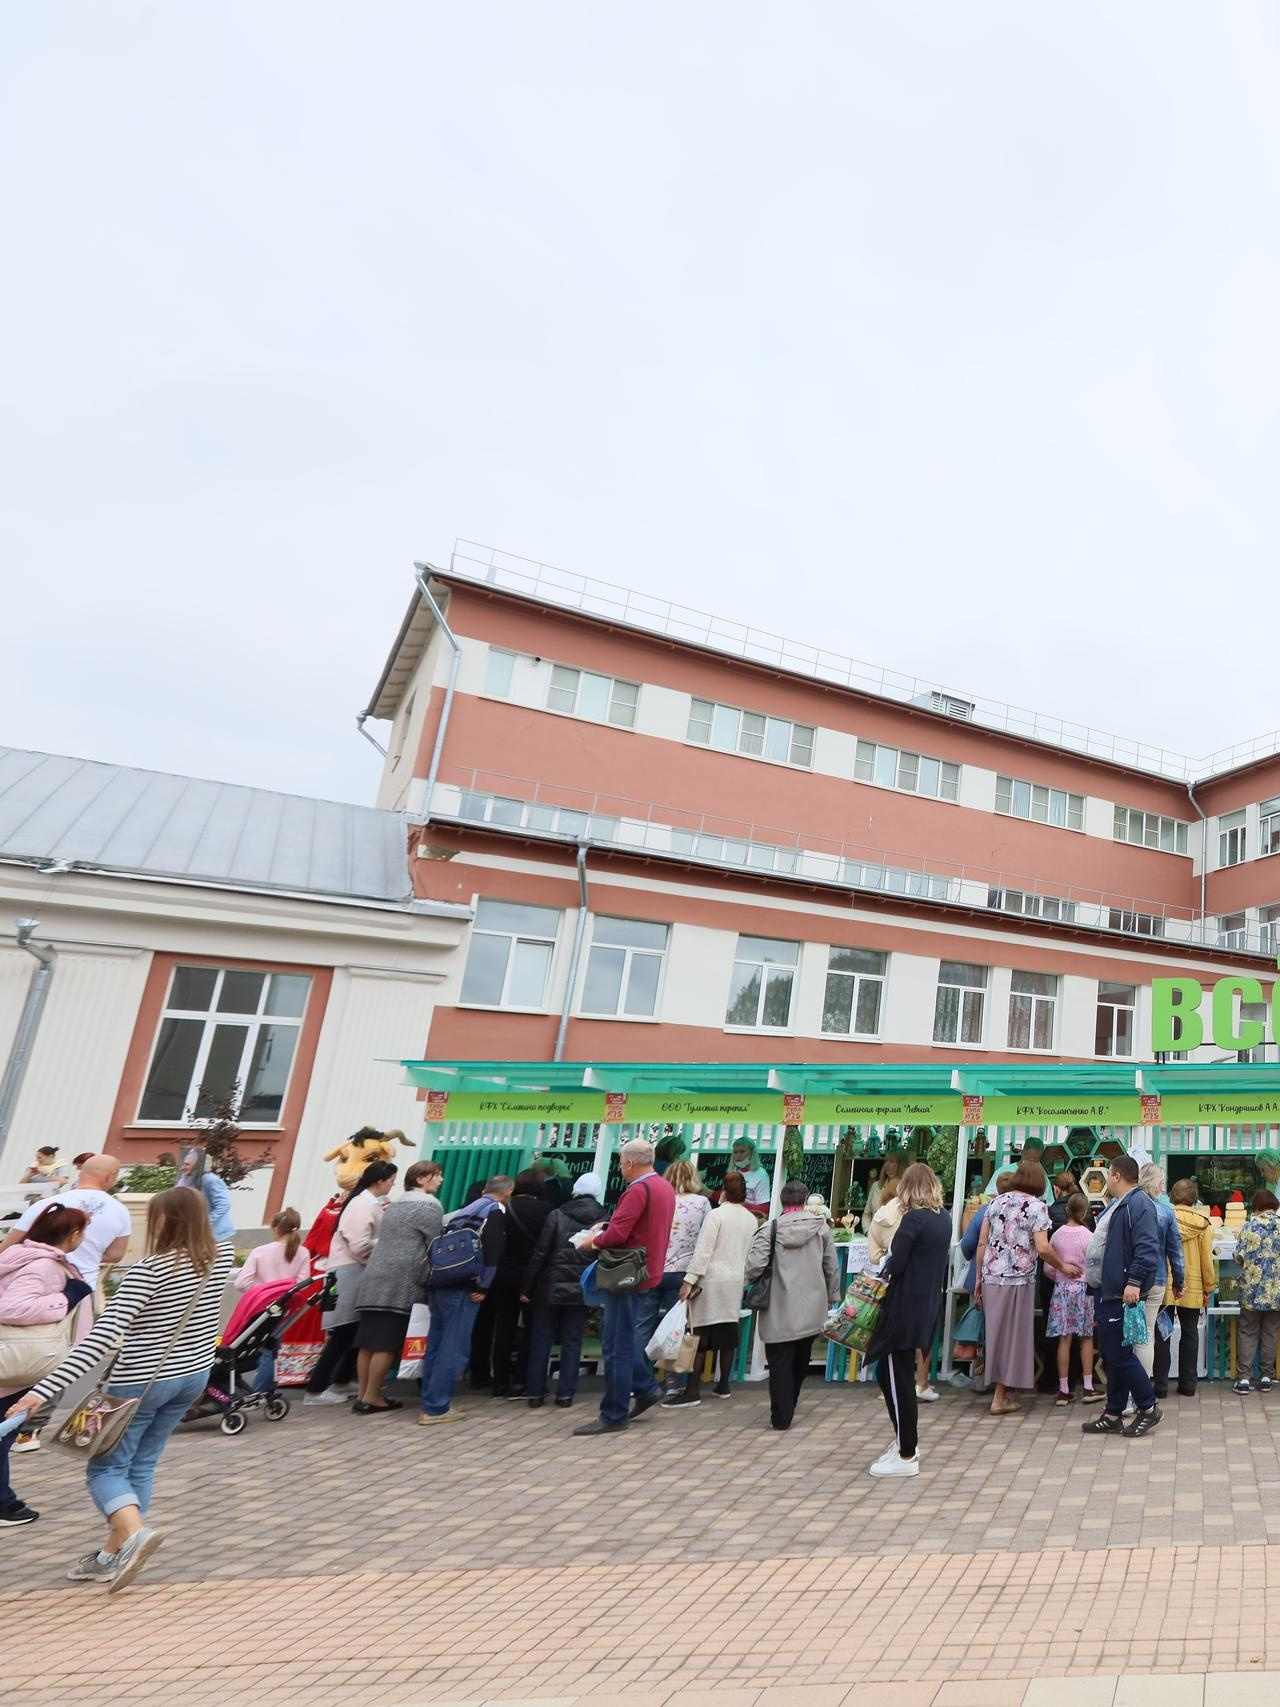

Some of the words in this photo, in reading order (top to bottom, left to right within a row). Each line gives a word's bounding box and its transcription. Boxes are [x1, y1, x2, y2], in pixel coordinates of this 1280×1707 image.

[480, 1101, 498, 1111] КФХ
[661, 1102, 682, 1112] ООО
[875, 1105, 902, 1116] ферма
[1016, 1105, 1034, 1115] КФХ
[1198, 1103, 1216, 1112] КФХ
